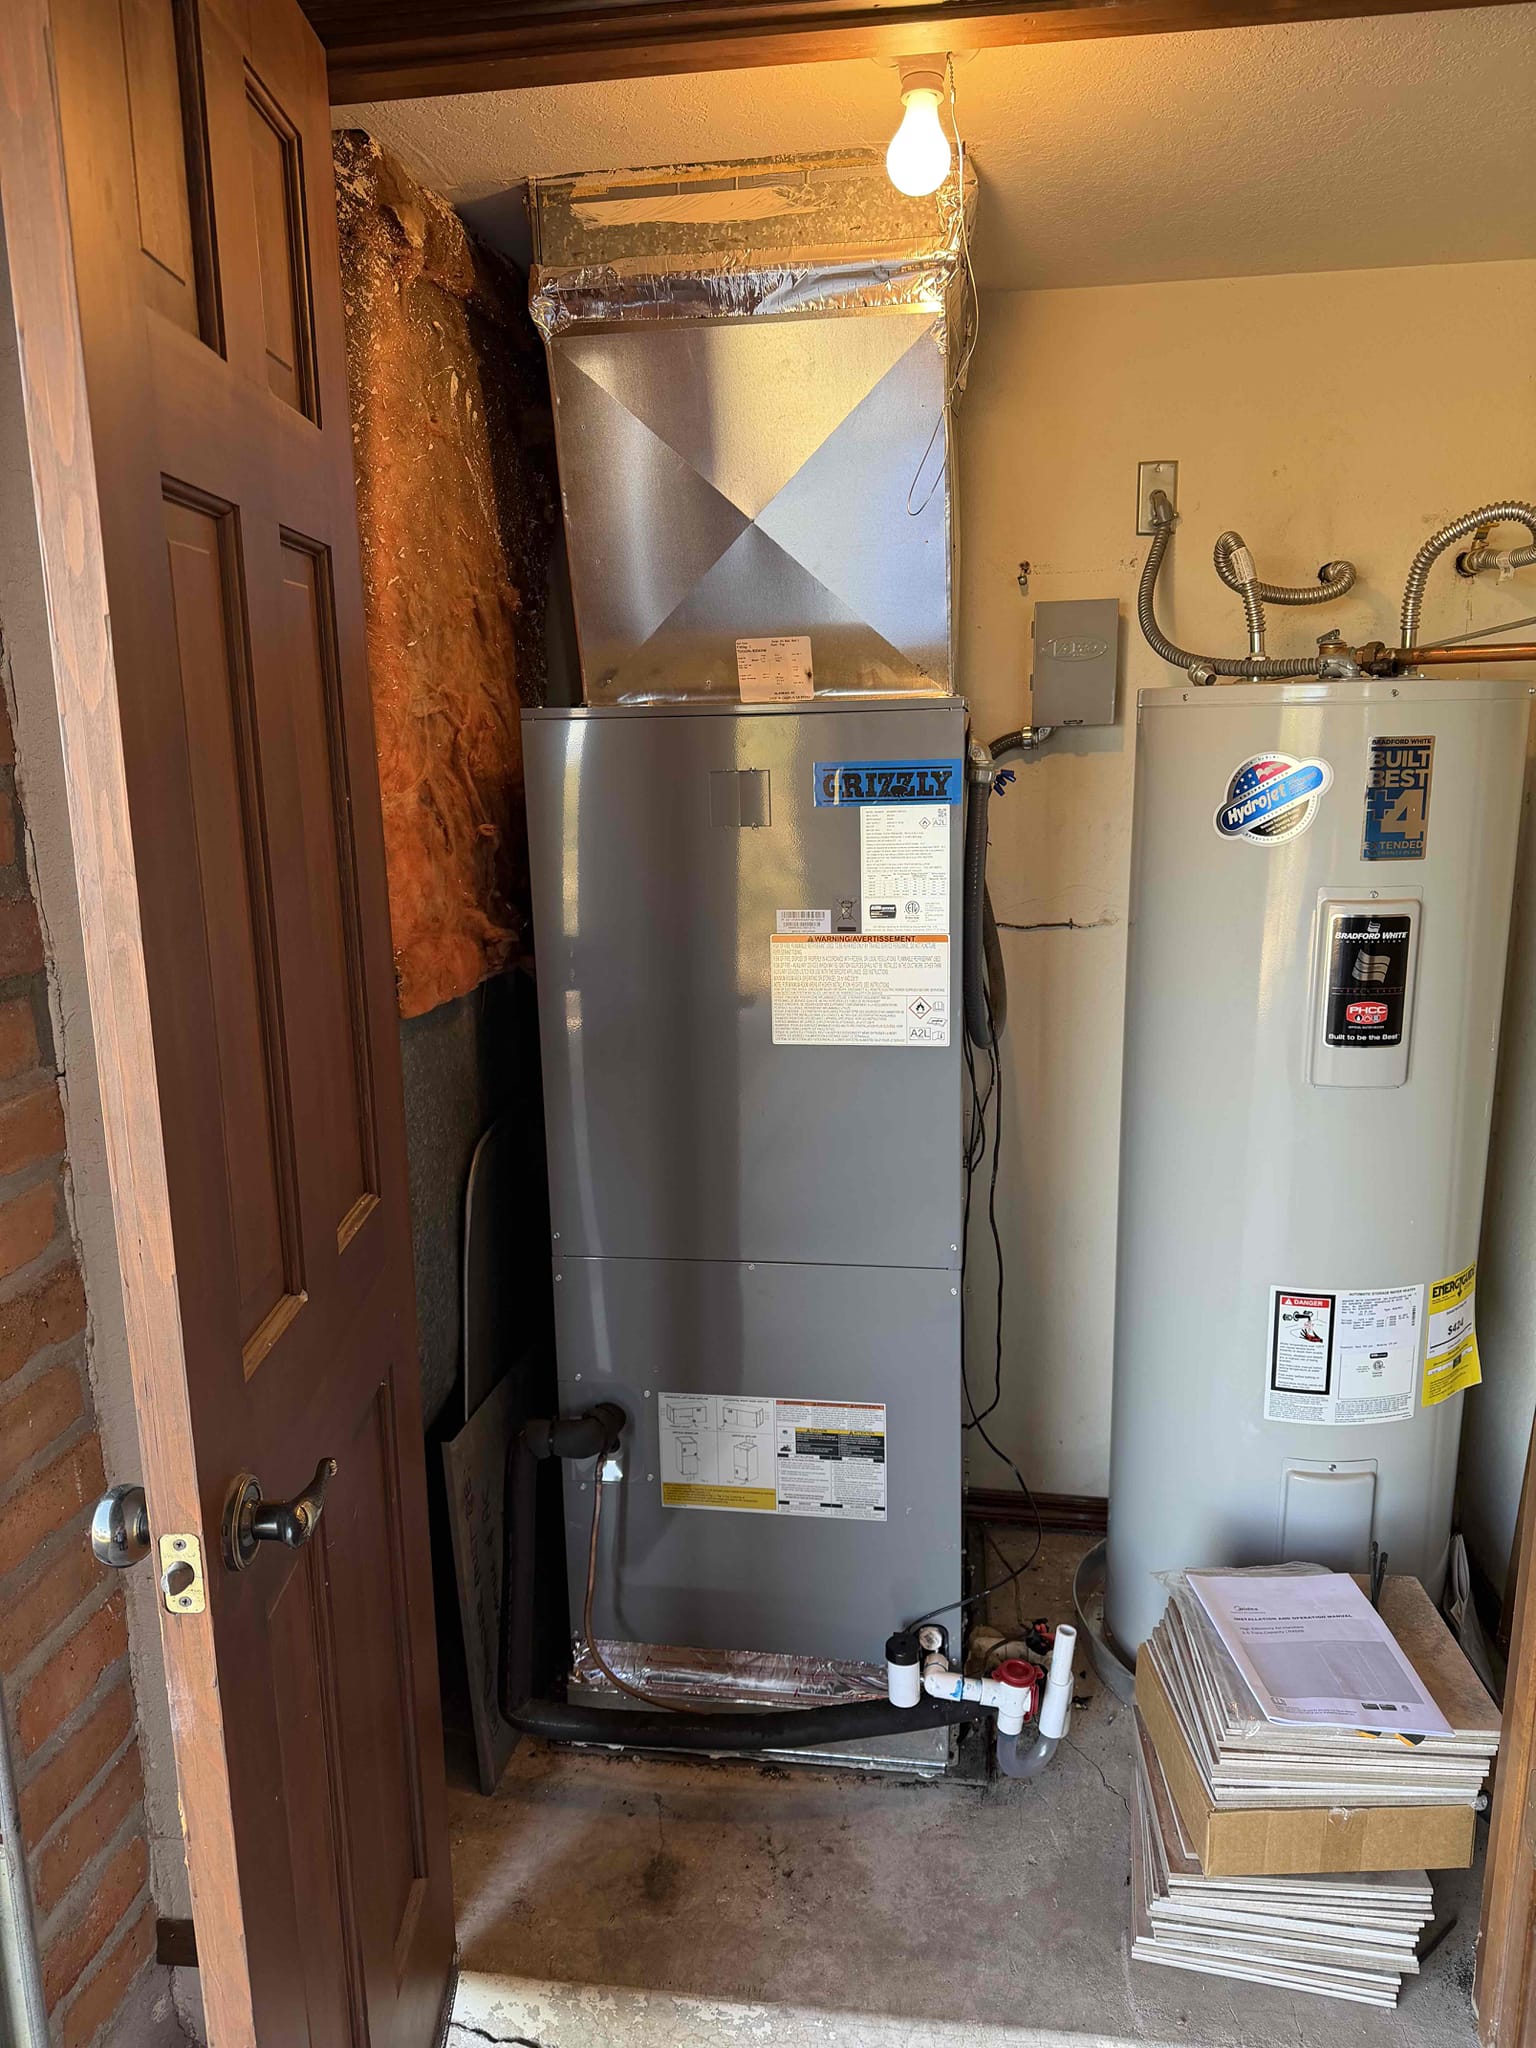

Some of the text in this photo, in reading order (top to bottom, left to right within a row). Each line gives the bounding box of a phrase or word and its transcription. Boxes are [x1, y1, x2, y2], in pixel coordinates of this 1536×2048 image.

[1368, 750, 1430, 768] BUILT
[822, 771, 952, 798] GRIZZLY
[1367, 769, 1429, 788] BEST
[1226, 783, 1287, 825] Hydrojet
[814, 935, 917, 943] WARNING/AVERTISSEMENT
[1335, 931, 1408, 940] BRADFORD WHITE
[1349, 1006, 1387, 1014] PHCC
[910, 1028, 931, 1038] A2L
